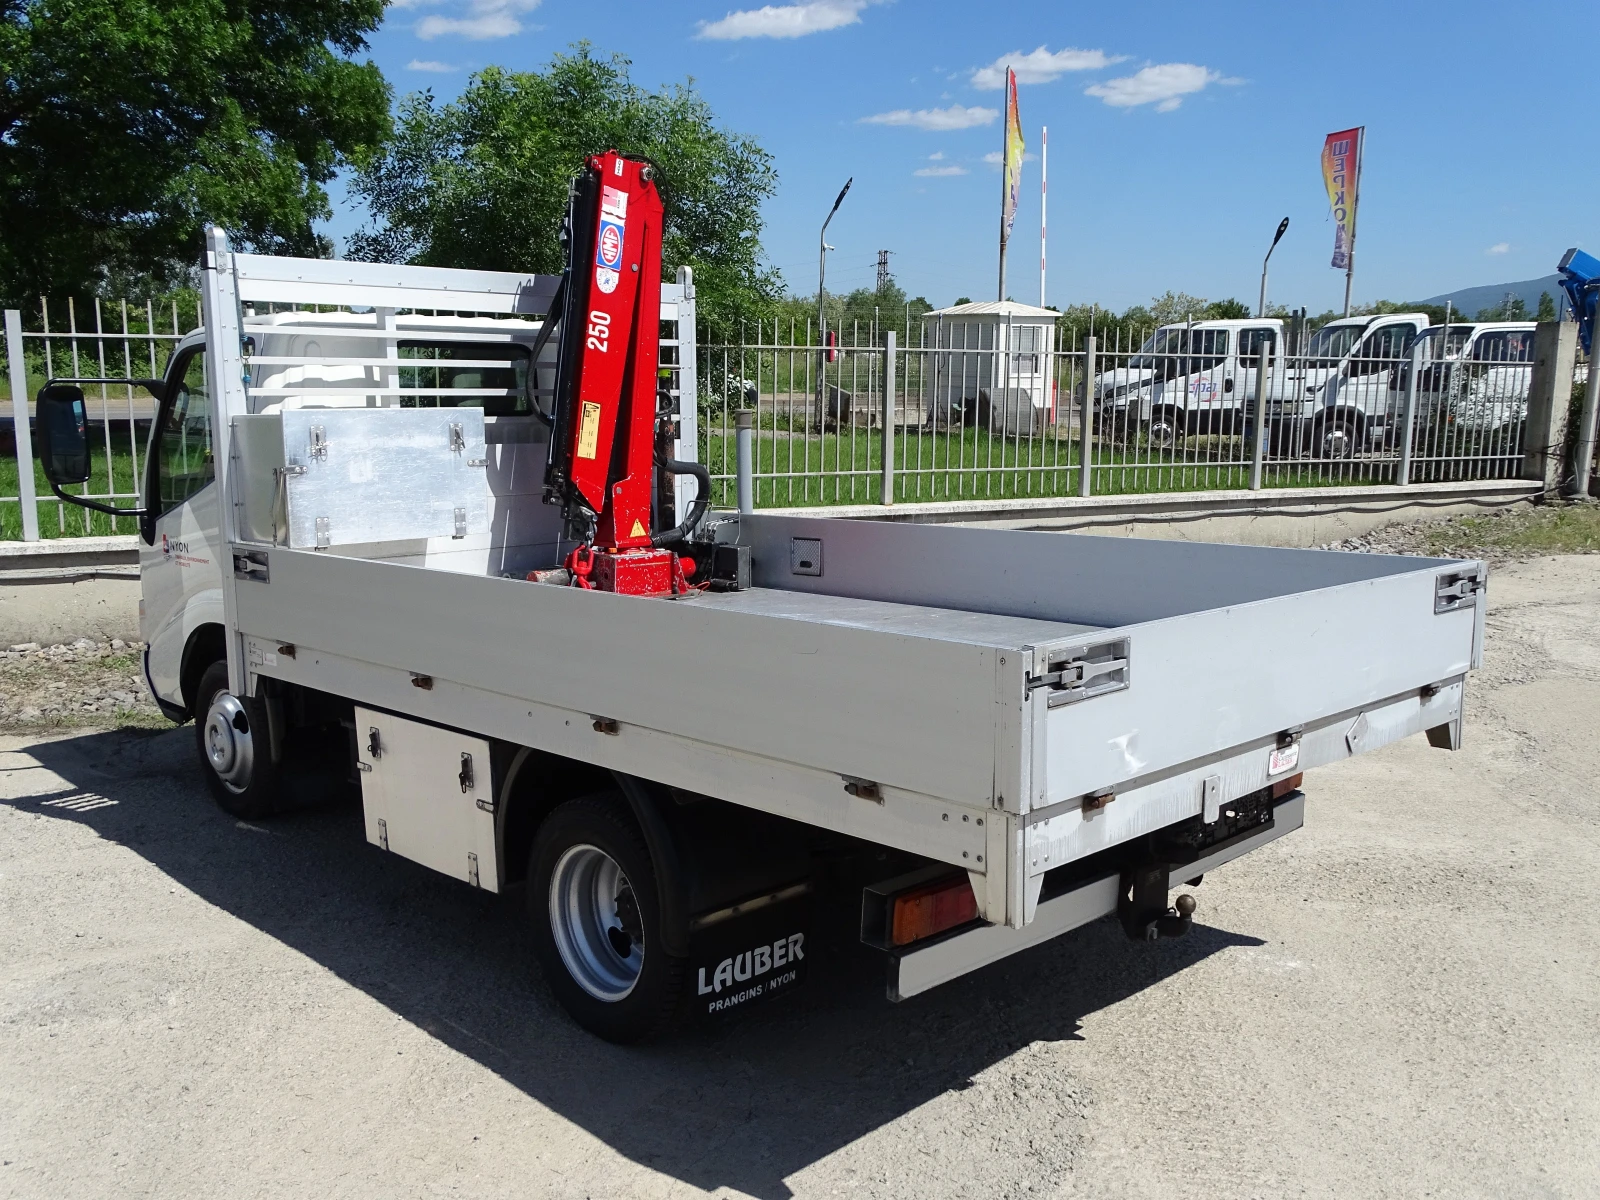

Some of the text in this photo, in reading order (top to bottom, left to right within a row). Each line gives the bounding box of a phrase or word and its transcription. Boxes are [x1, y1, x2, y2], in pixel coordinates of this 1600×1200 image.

[602, 230, 620, 262] HMF
[587, 310, 611, 353] 250
[169, 540, 190, 554] NYON
[697, 932, 805, 996] LAUBER
[708, 985, 763, 1014] PRANGINS
[769, 969, 796, 990] NYON
